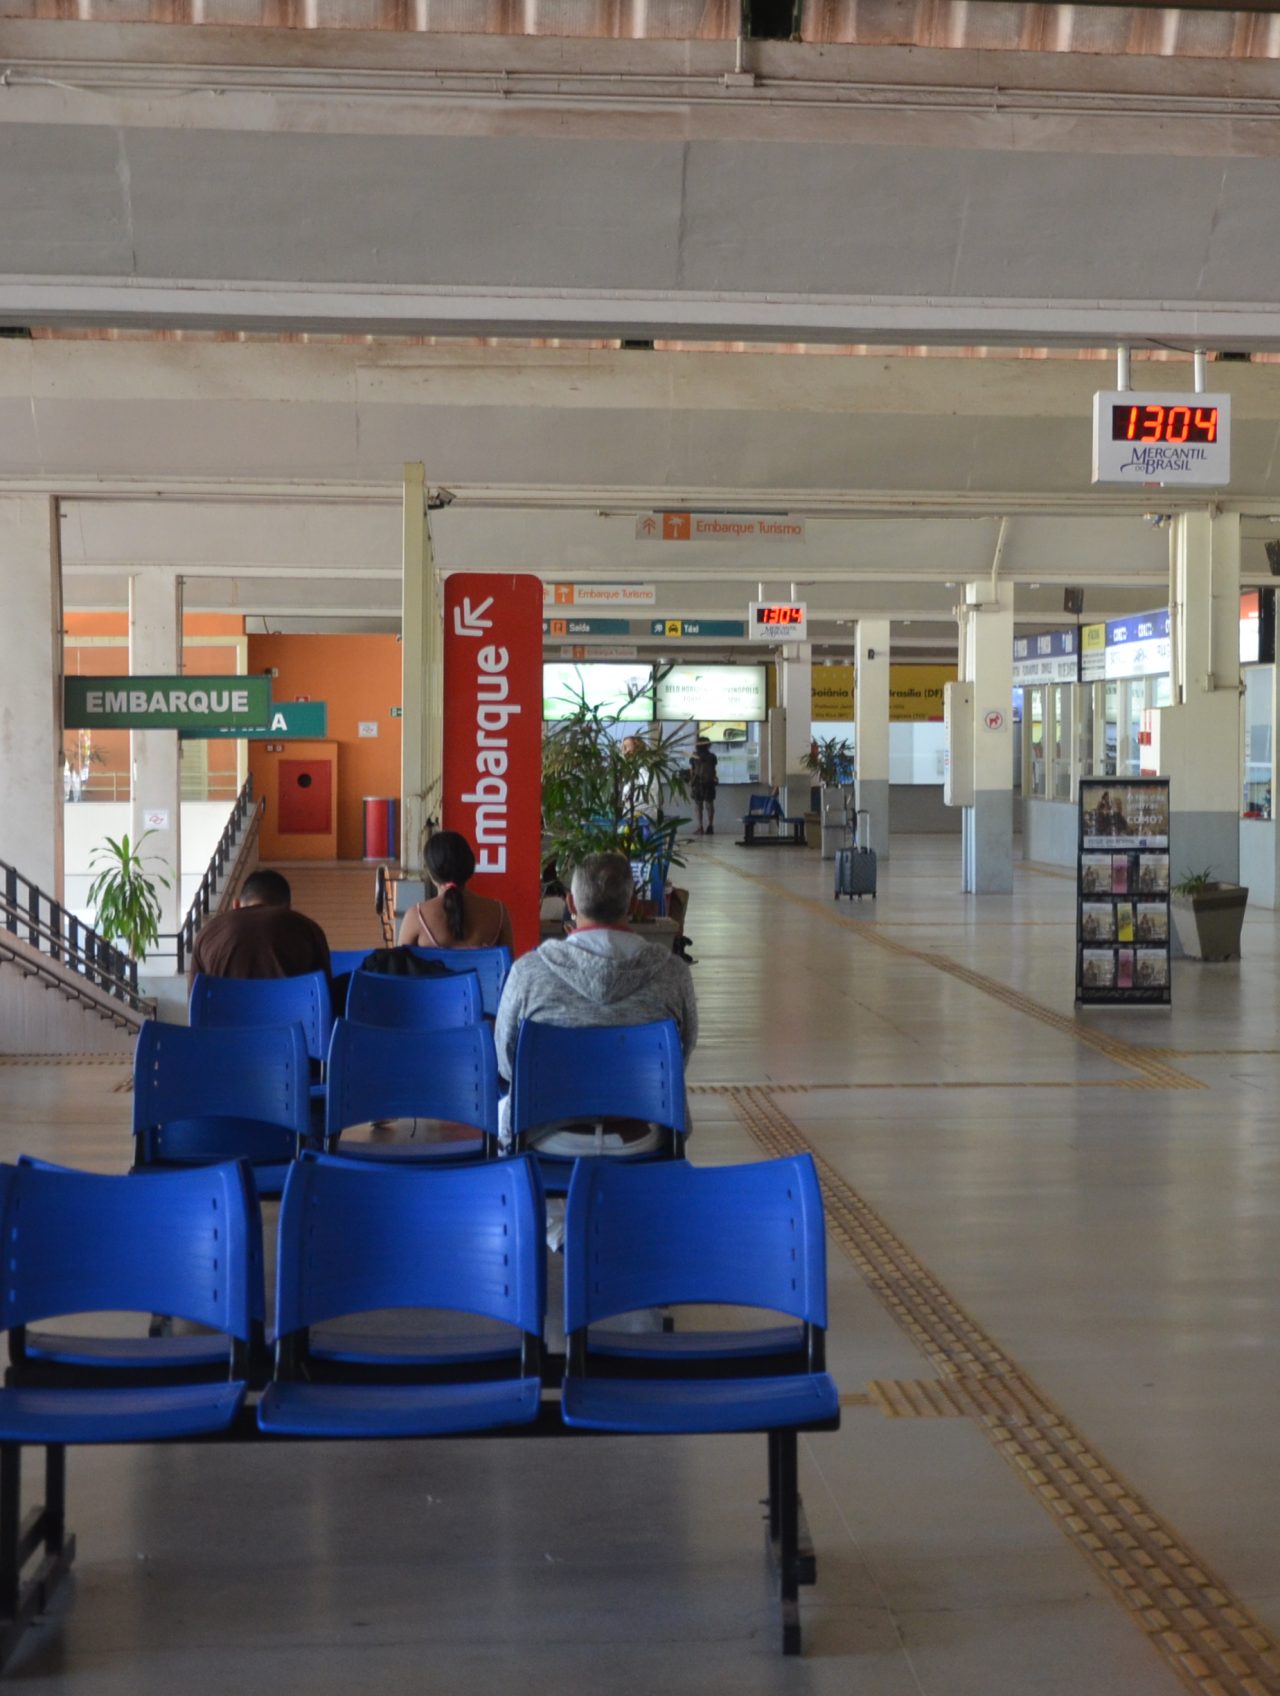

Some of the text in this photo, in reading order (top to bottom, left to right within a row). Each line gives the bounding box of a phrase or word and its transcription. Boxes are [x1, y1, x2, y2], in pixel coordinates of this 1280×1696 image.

[1127, 405, 1218, 443] 1304
[1131, 447, 1207, 464] MERCANTIL
[1145, 459, 1192, 475] BRASIL
[696, 519, 802, 536] Embarque Turismo
[578, 589, 654, 600] Embarque Turismo
[85, 690, 249, 714] EMBARQUE
[461, 644, 521, 874] Embarque
